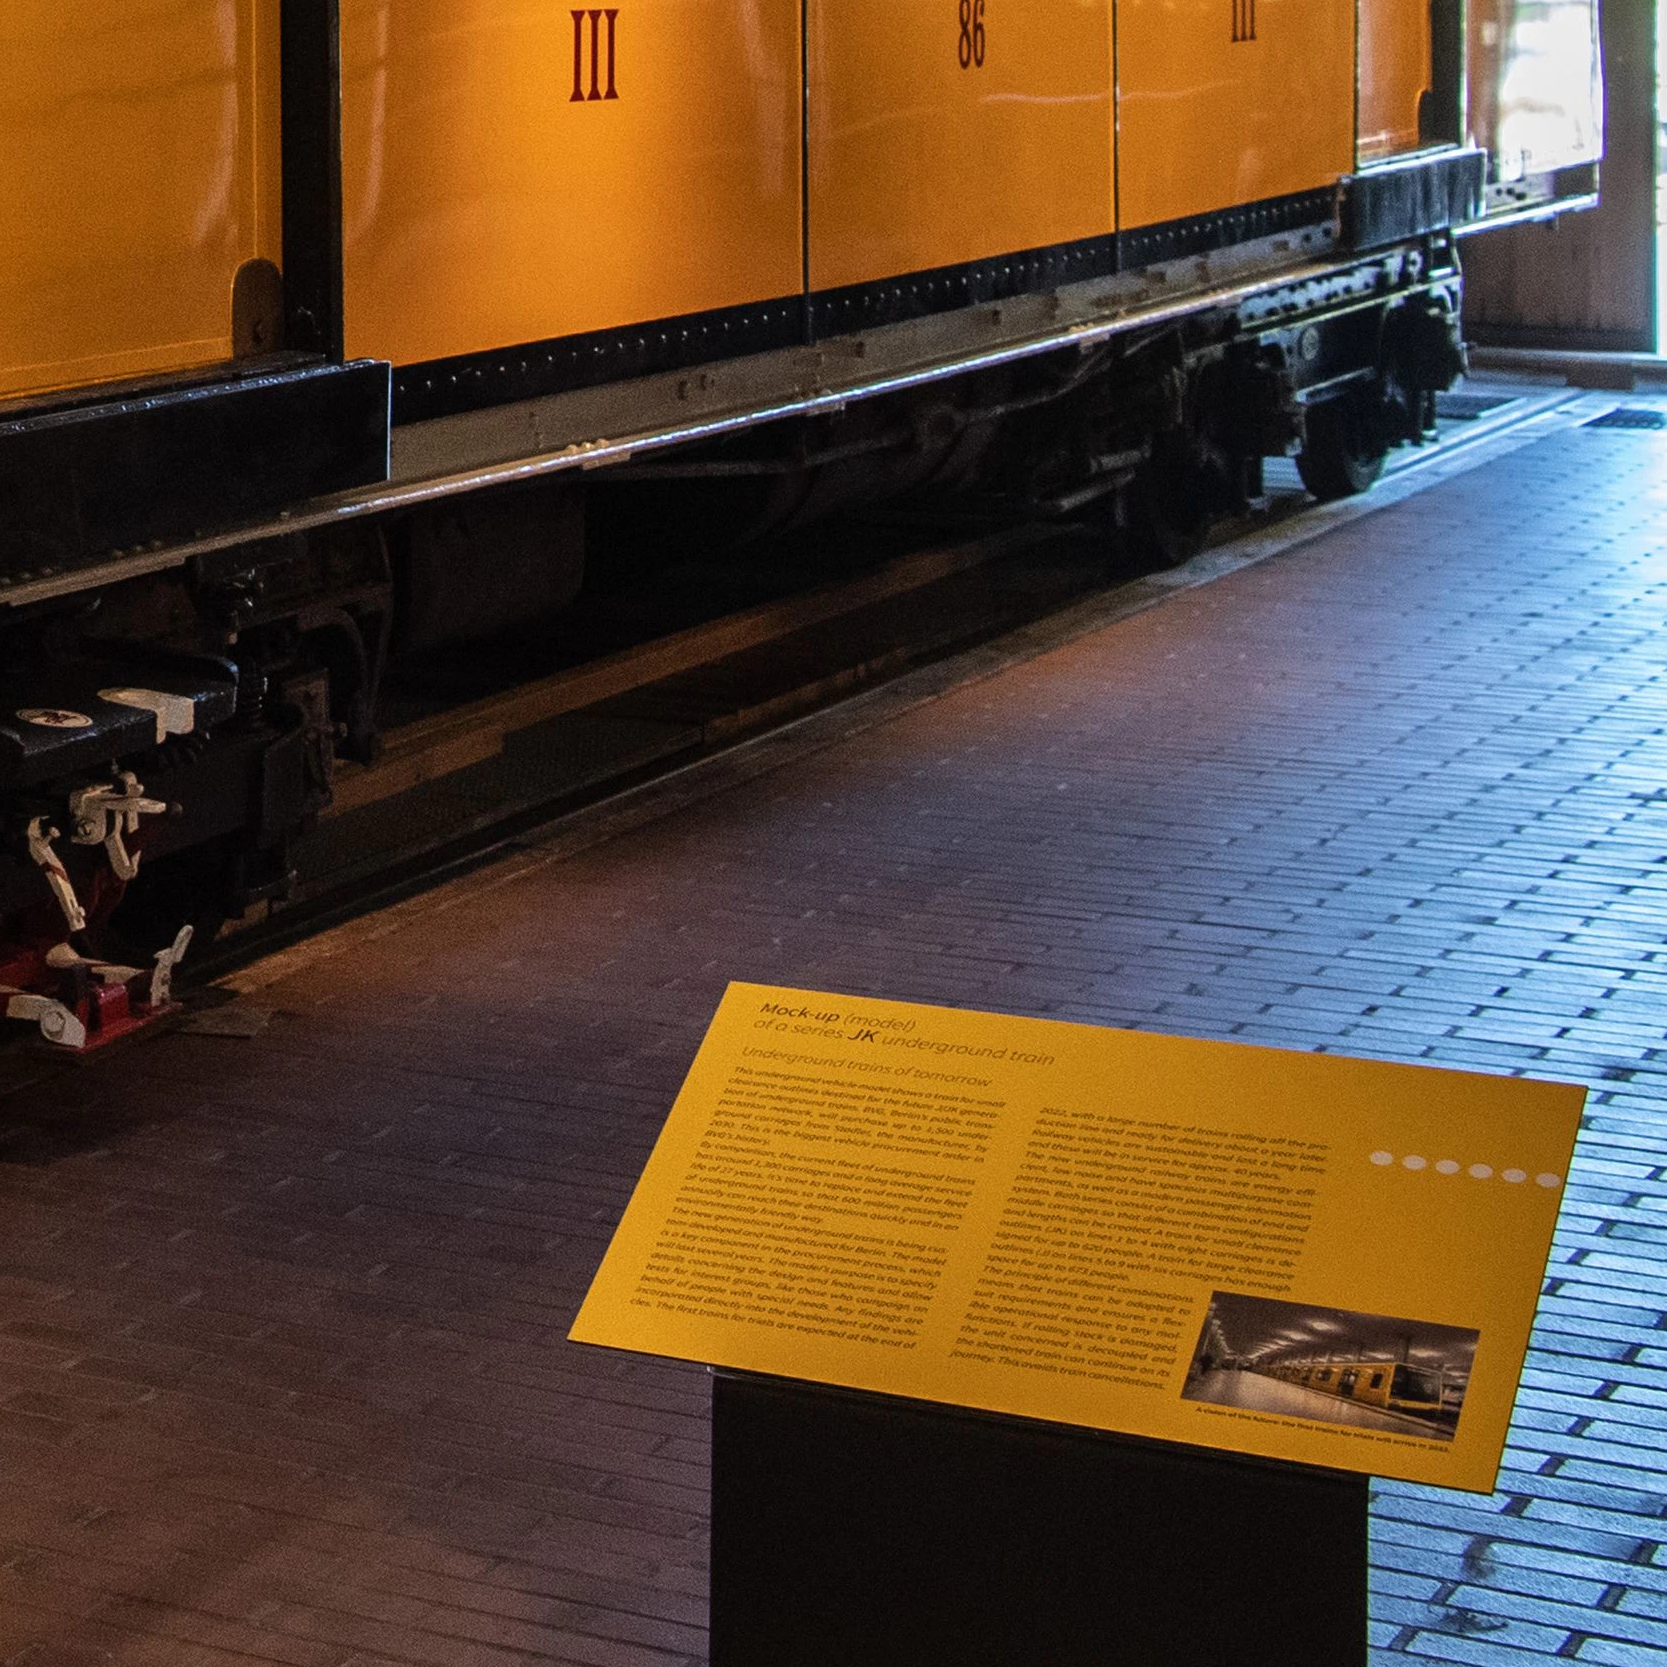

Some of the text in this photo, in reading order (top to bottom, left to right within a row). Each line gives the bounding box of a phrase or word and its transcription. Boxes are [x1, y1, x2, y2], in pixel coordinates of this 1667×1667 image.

[569, 9, 619, 102] III
[759, 1002, 915, 1032] Mock-up (model)
[753, 1018, 775, 1029] of
[791, 1025, 843, 1038] series
[846, 1029, 880, 1042] JK
[881, 1036, 1007, 1058] underground
[1009, 1051, 1055, 1065] train
[742, 1046, 992, 1086] Underground trains of tomorrow
